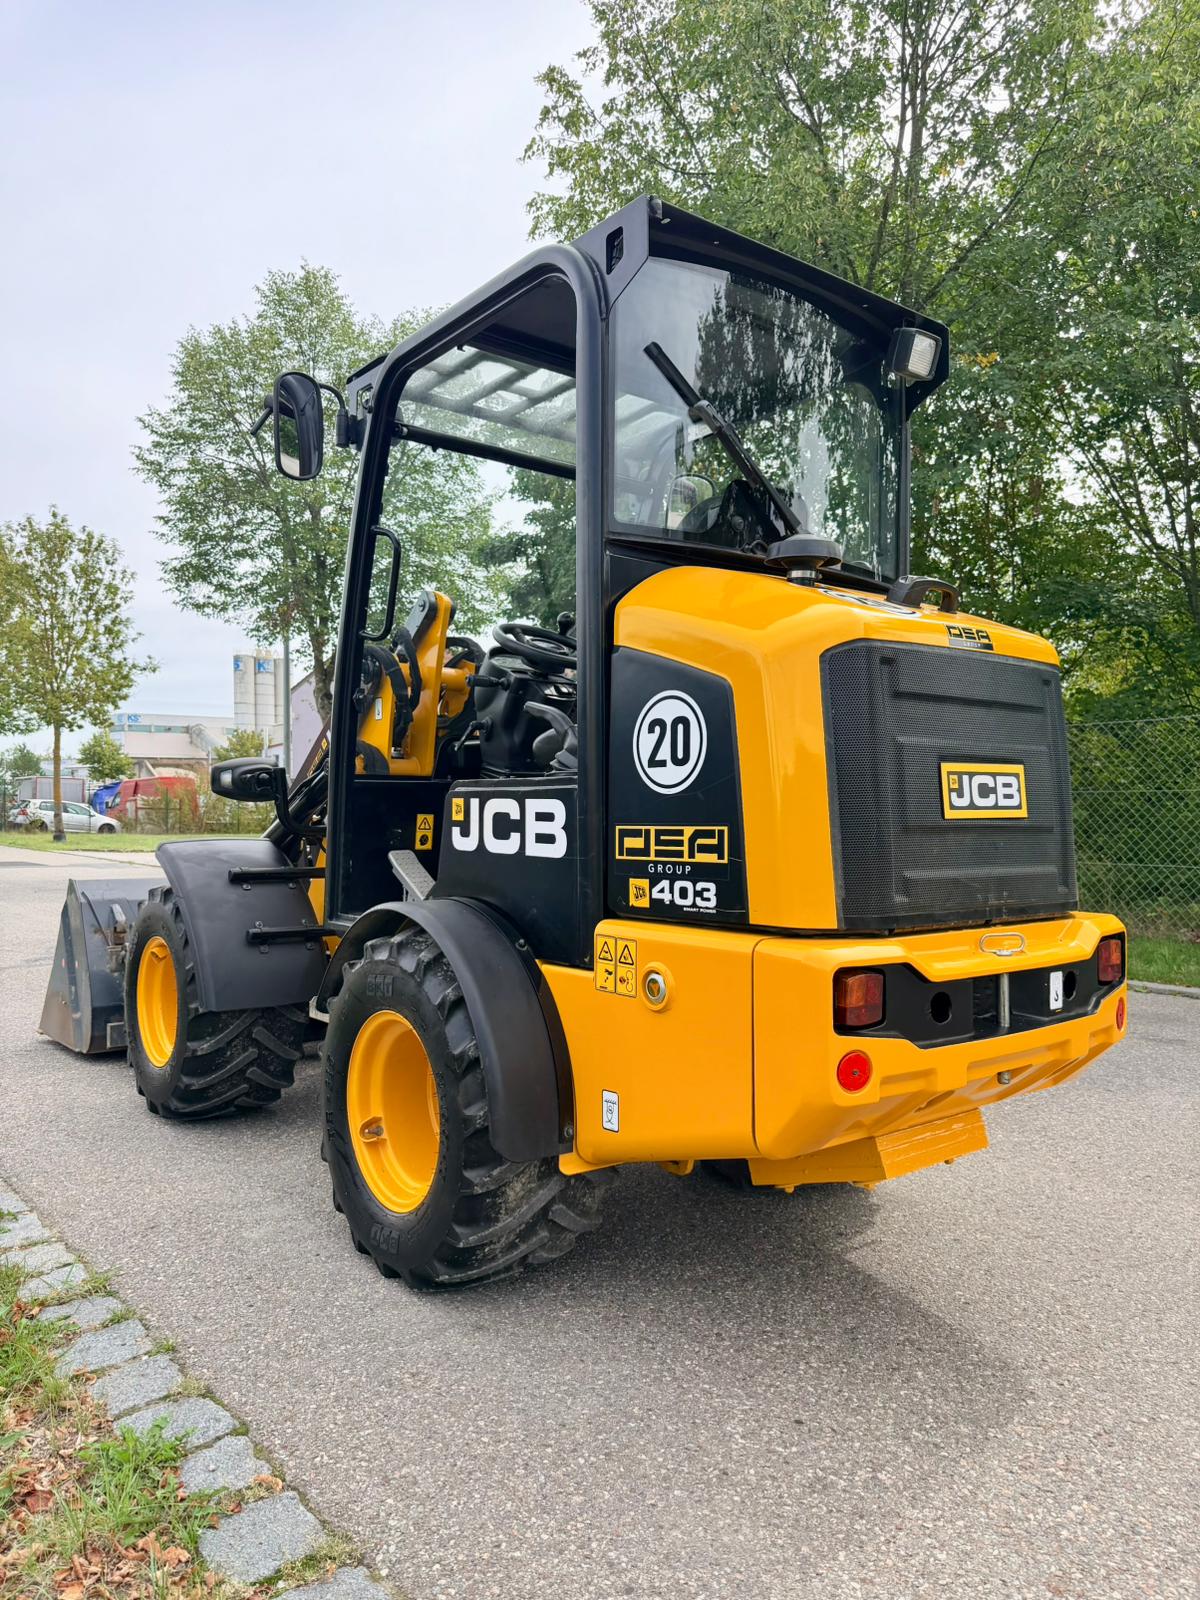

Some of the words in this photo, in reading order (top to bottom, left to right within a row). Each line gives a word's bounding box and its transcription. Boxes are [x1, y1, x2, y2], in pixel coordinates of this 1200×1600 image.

[647, 715, 691, 768] 20
[950, 774, 1020, 807] JCB
[452, 797, 568, 859] JCB
[647, 863, 692, 875] GROUP
[652, 880, 717, 908] 403
